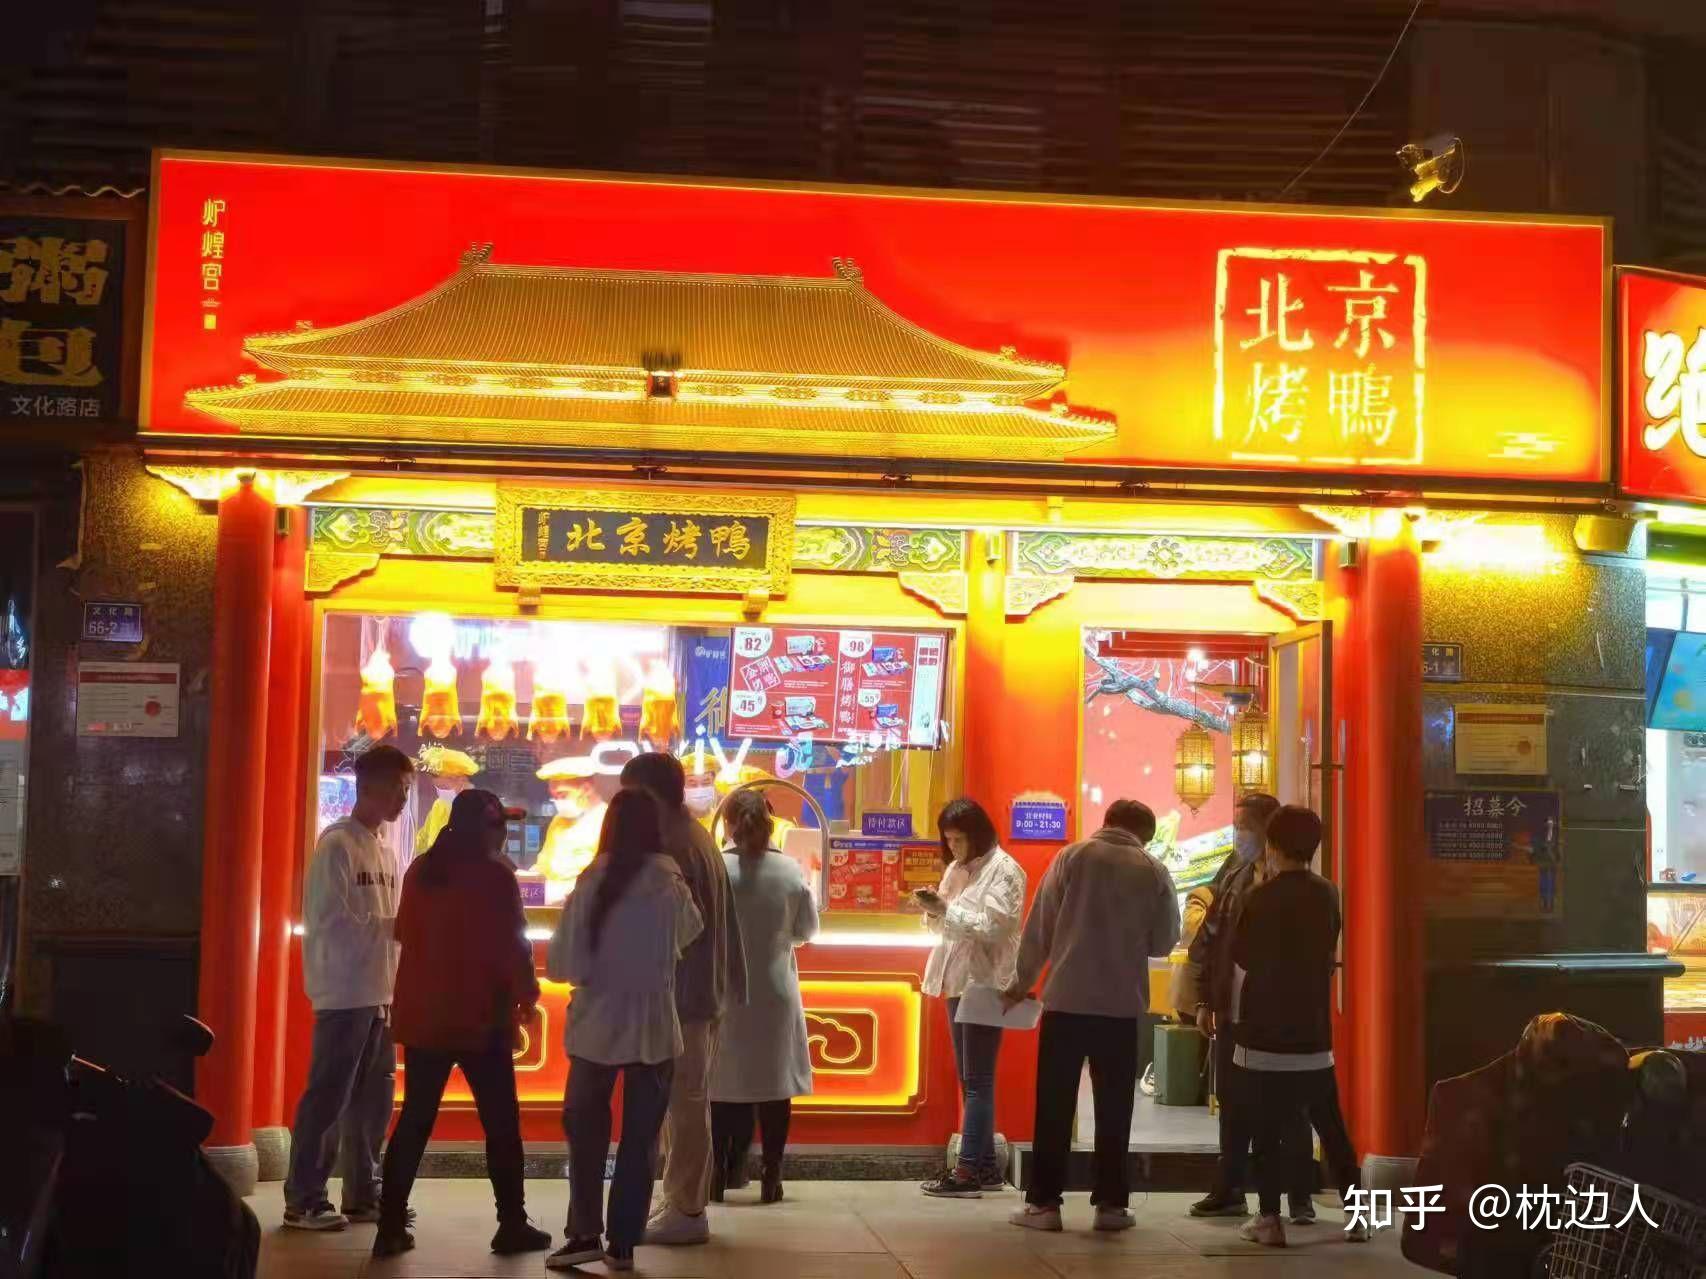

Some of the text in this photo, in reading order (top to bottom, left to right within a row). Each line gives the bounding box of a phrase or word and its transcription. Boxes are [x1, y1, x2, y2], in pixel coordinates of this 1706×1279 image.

[201, 198, 226, 290] 炉煌宫
[1240, 270, 1399, 359] 北京
[11, 395, 100, 417] 文化路店
[849, 640, 865, 653] 98
[740, 698, 756, 712] 45
[1464, 794, 1527, 817] 招募令
[1040, 820, 1061, 829] 21:30
